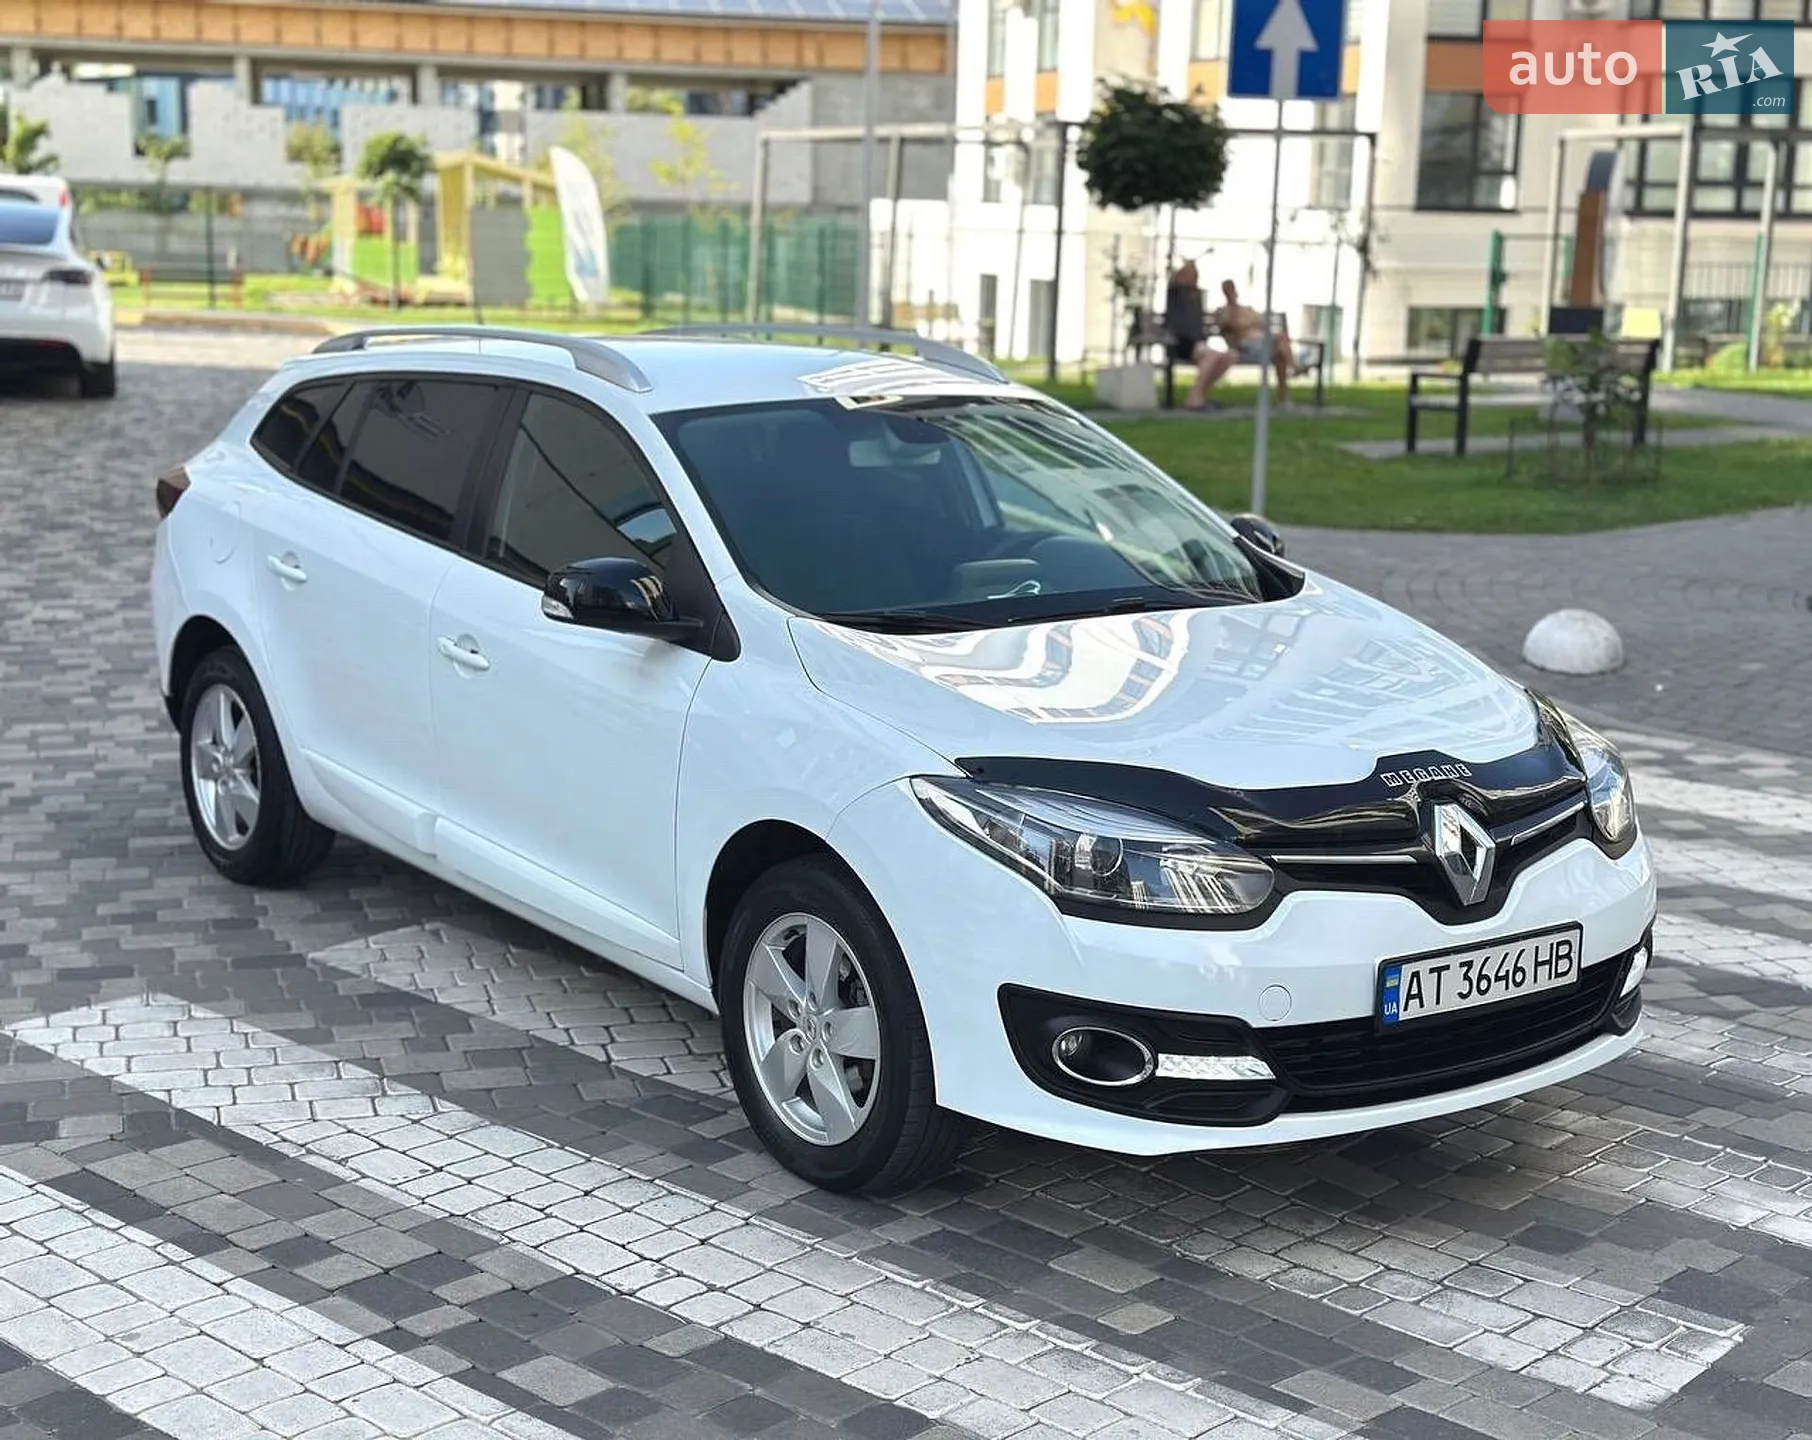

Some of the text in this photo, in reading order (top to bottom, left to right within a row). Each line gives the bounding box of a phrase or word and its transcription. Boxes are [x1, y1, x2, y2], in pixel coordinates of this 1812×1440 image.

[1380, 763, 1473, 787] MEGANE
[1403, 939, 1574, 1012] AT 3646 HB
[1384, 1001, 1398, 1016] UA
